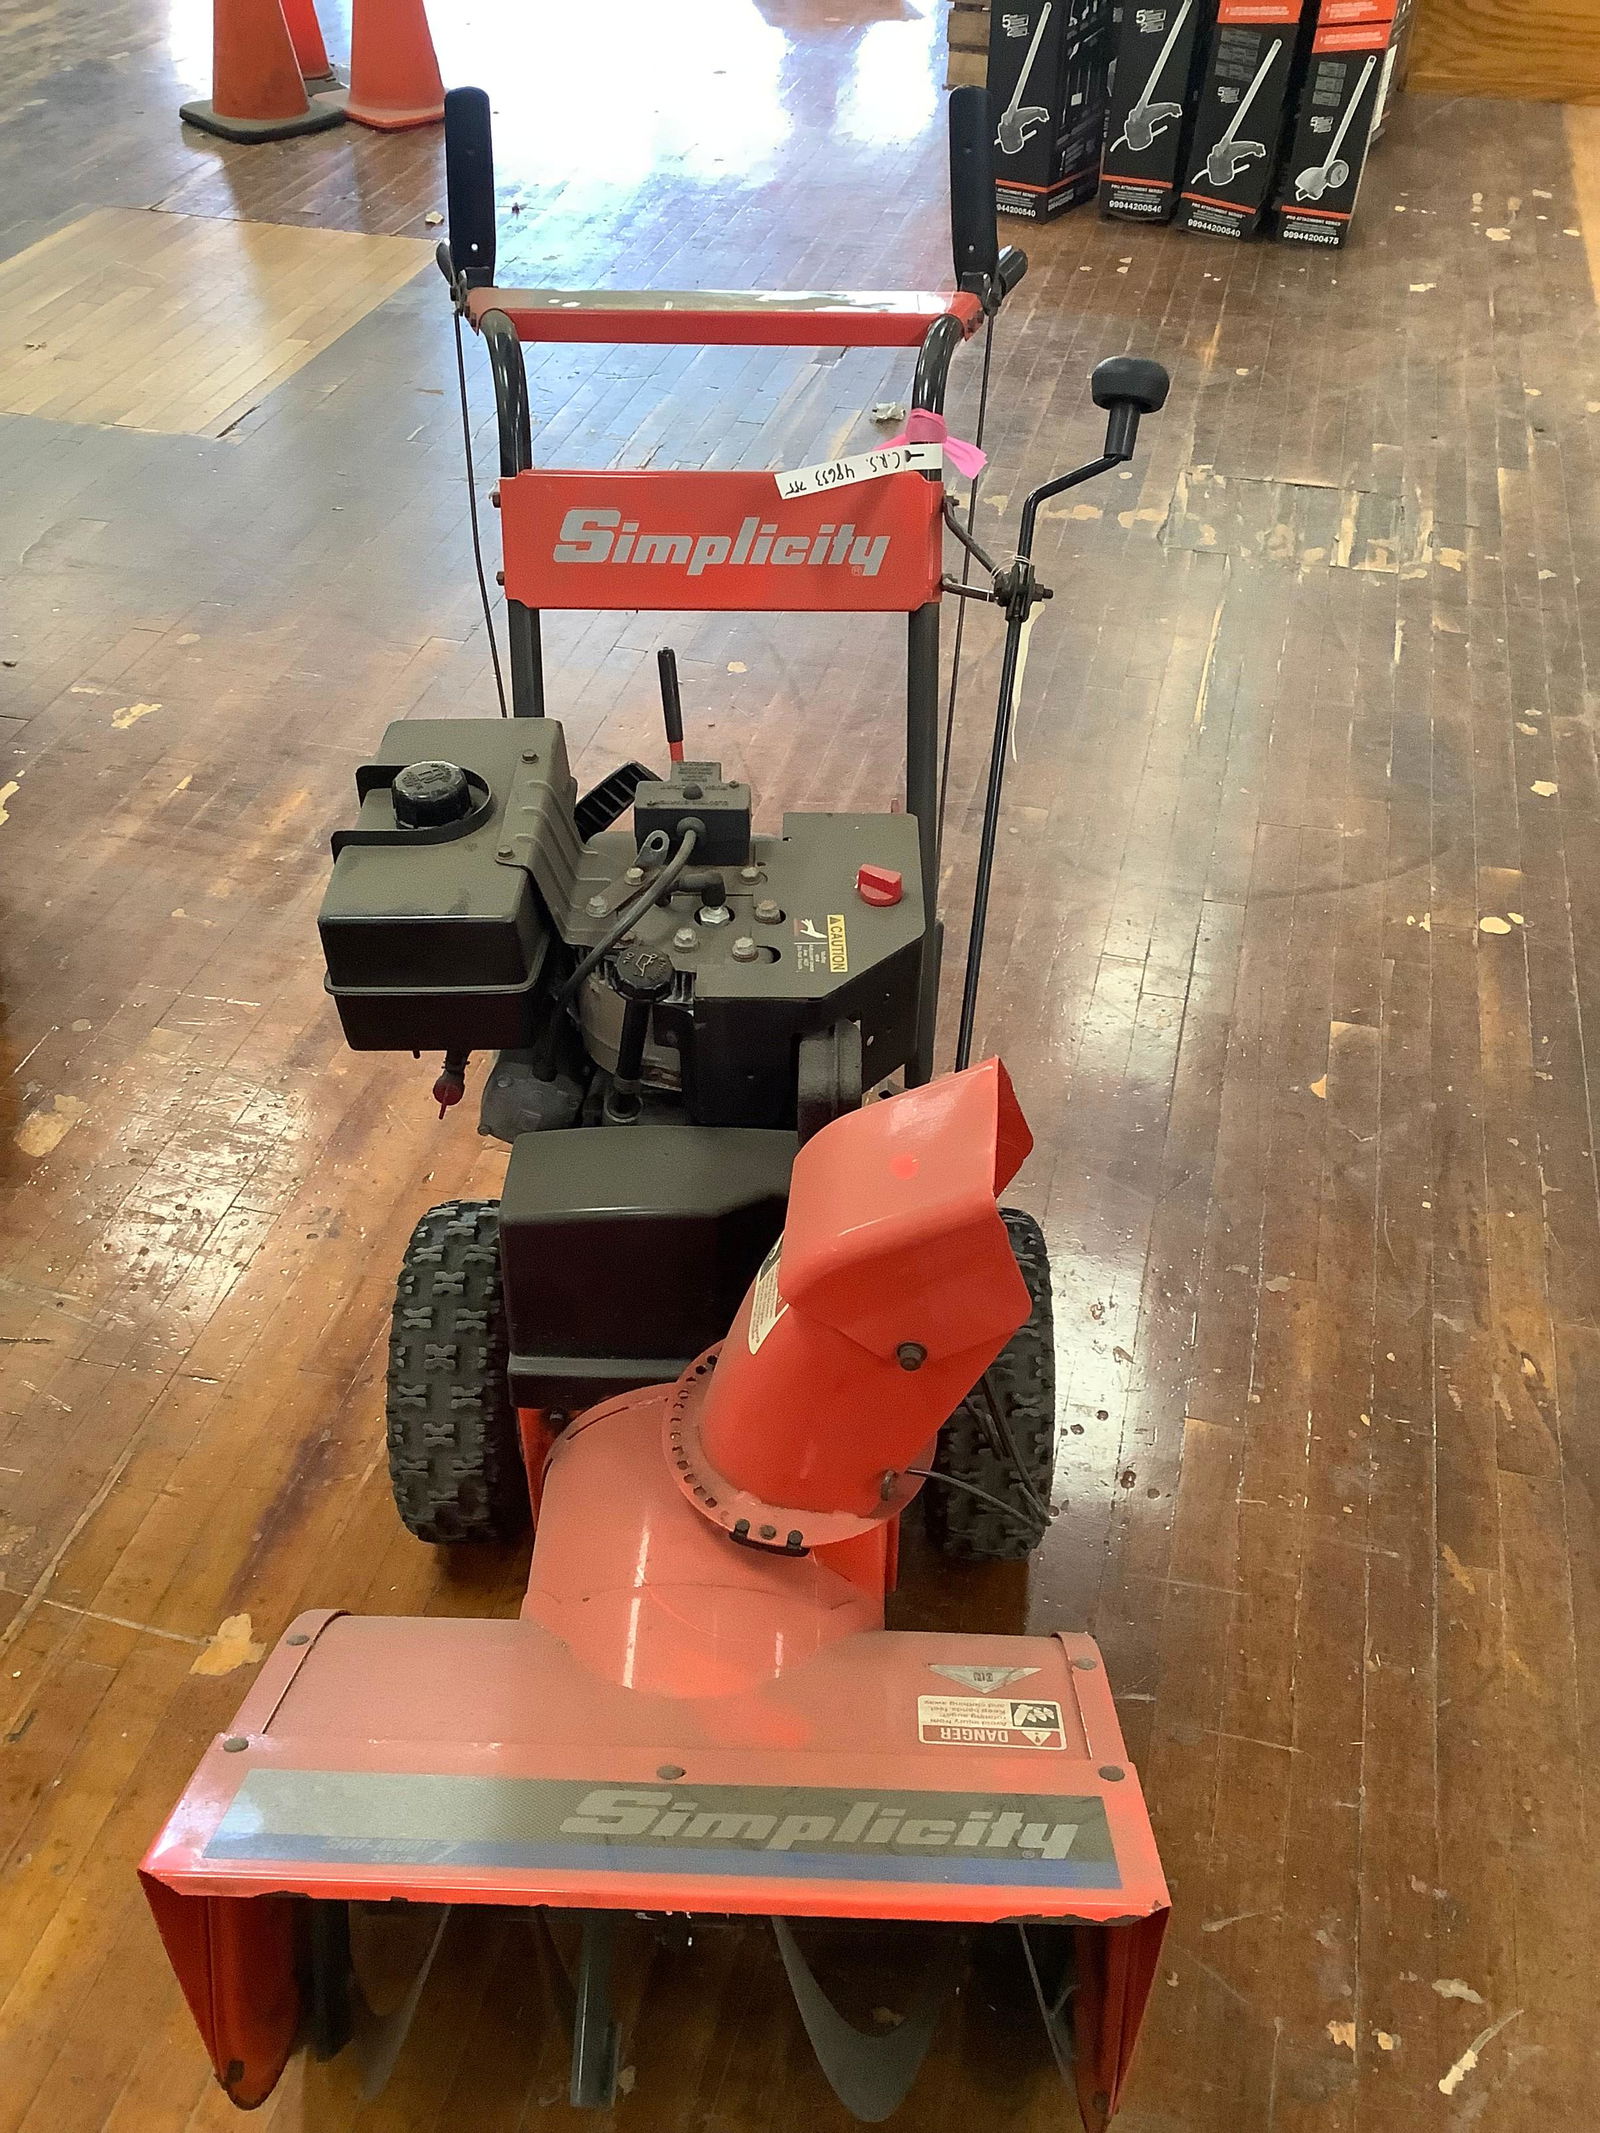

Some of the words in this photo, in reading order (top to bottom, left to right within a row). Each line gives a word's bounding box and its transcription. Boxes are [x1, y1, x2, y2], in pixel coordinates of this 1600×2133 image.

[1109, 200, 1162, 213] 99944200540
[1187, 218, 1241, 237] 99944200540
[1283, 230, 1340, 245] 99944200475
[553, 509, 890, 576] Simplicity
[830, 925, 846, 970] CAUTION
[940, 1727, 1009, 1743] DANGER
[558, 1790, 1079, 1860] Simplicity
